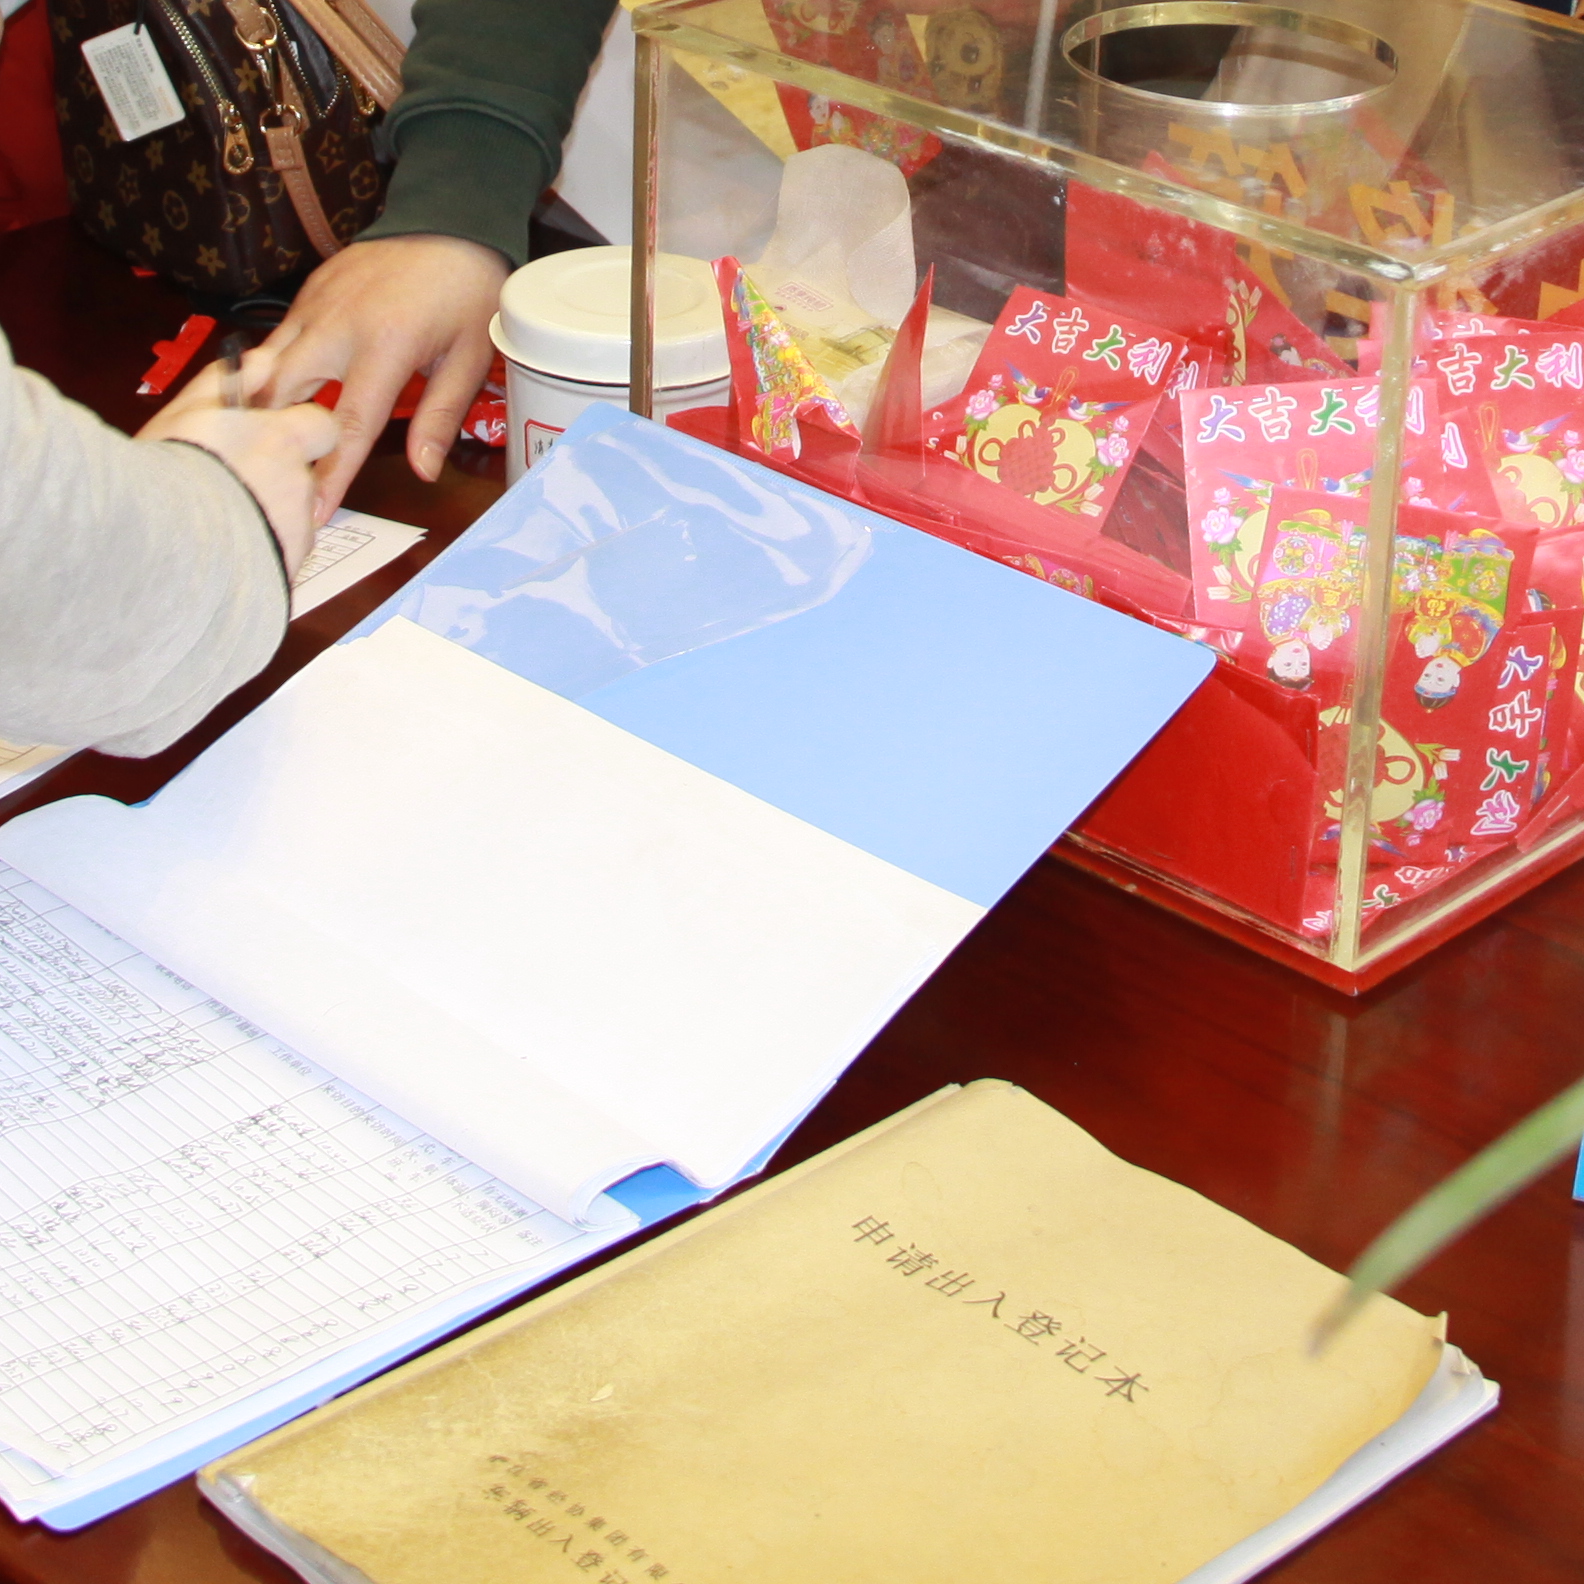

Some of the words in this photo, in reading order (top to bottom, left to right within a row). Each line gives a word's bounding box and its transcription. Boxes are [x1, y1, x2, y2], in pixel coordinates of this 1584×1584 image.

[1005, 300, 1173, 386] 大吉大利
[1470, 645, 1544, 835] 大吉大利
[851, 1214, 1150, 1403] 申请出入登记本
